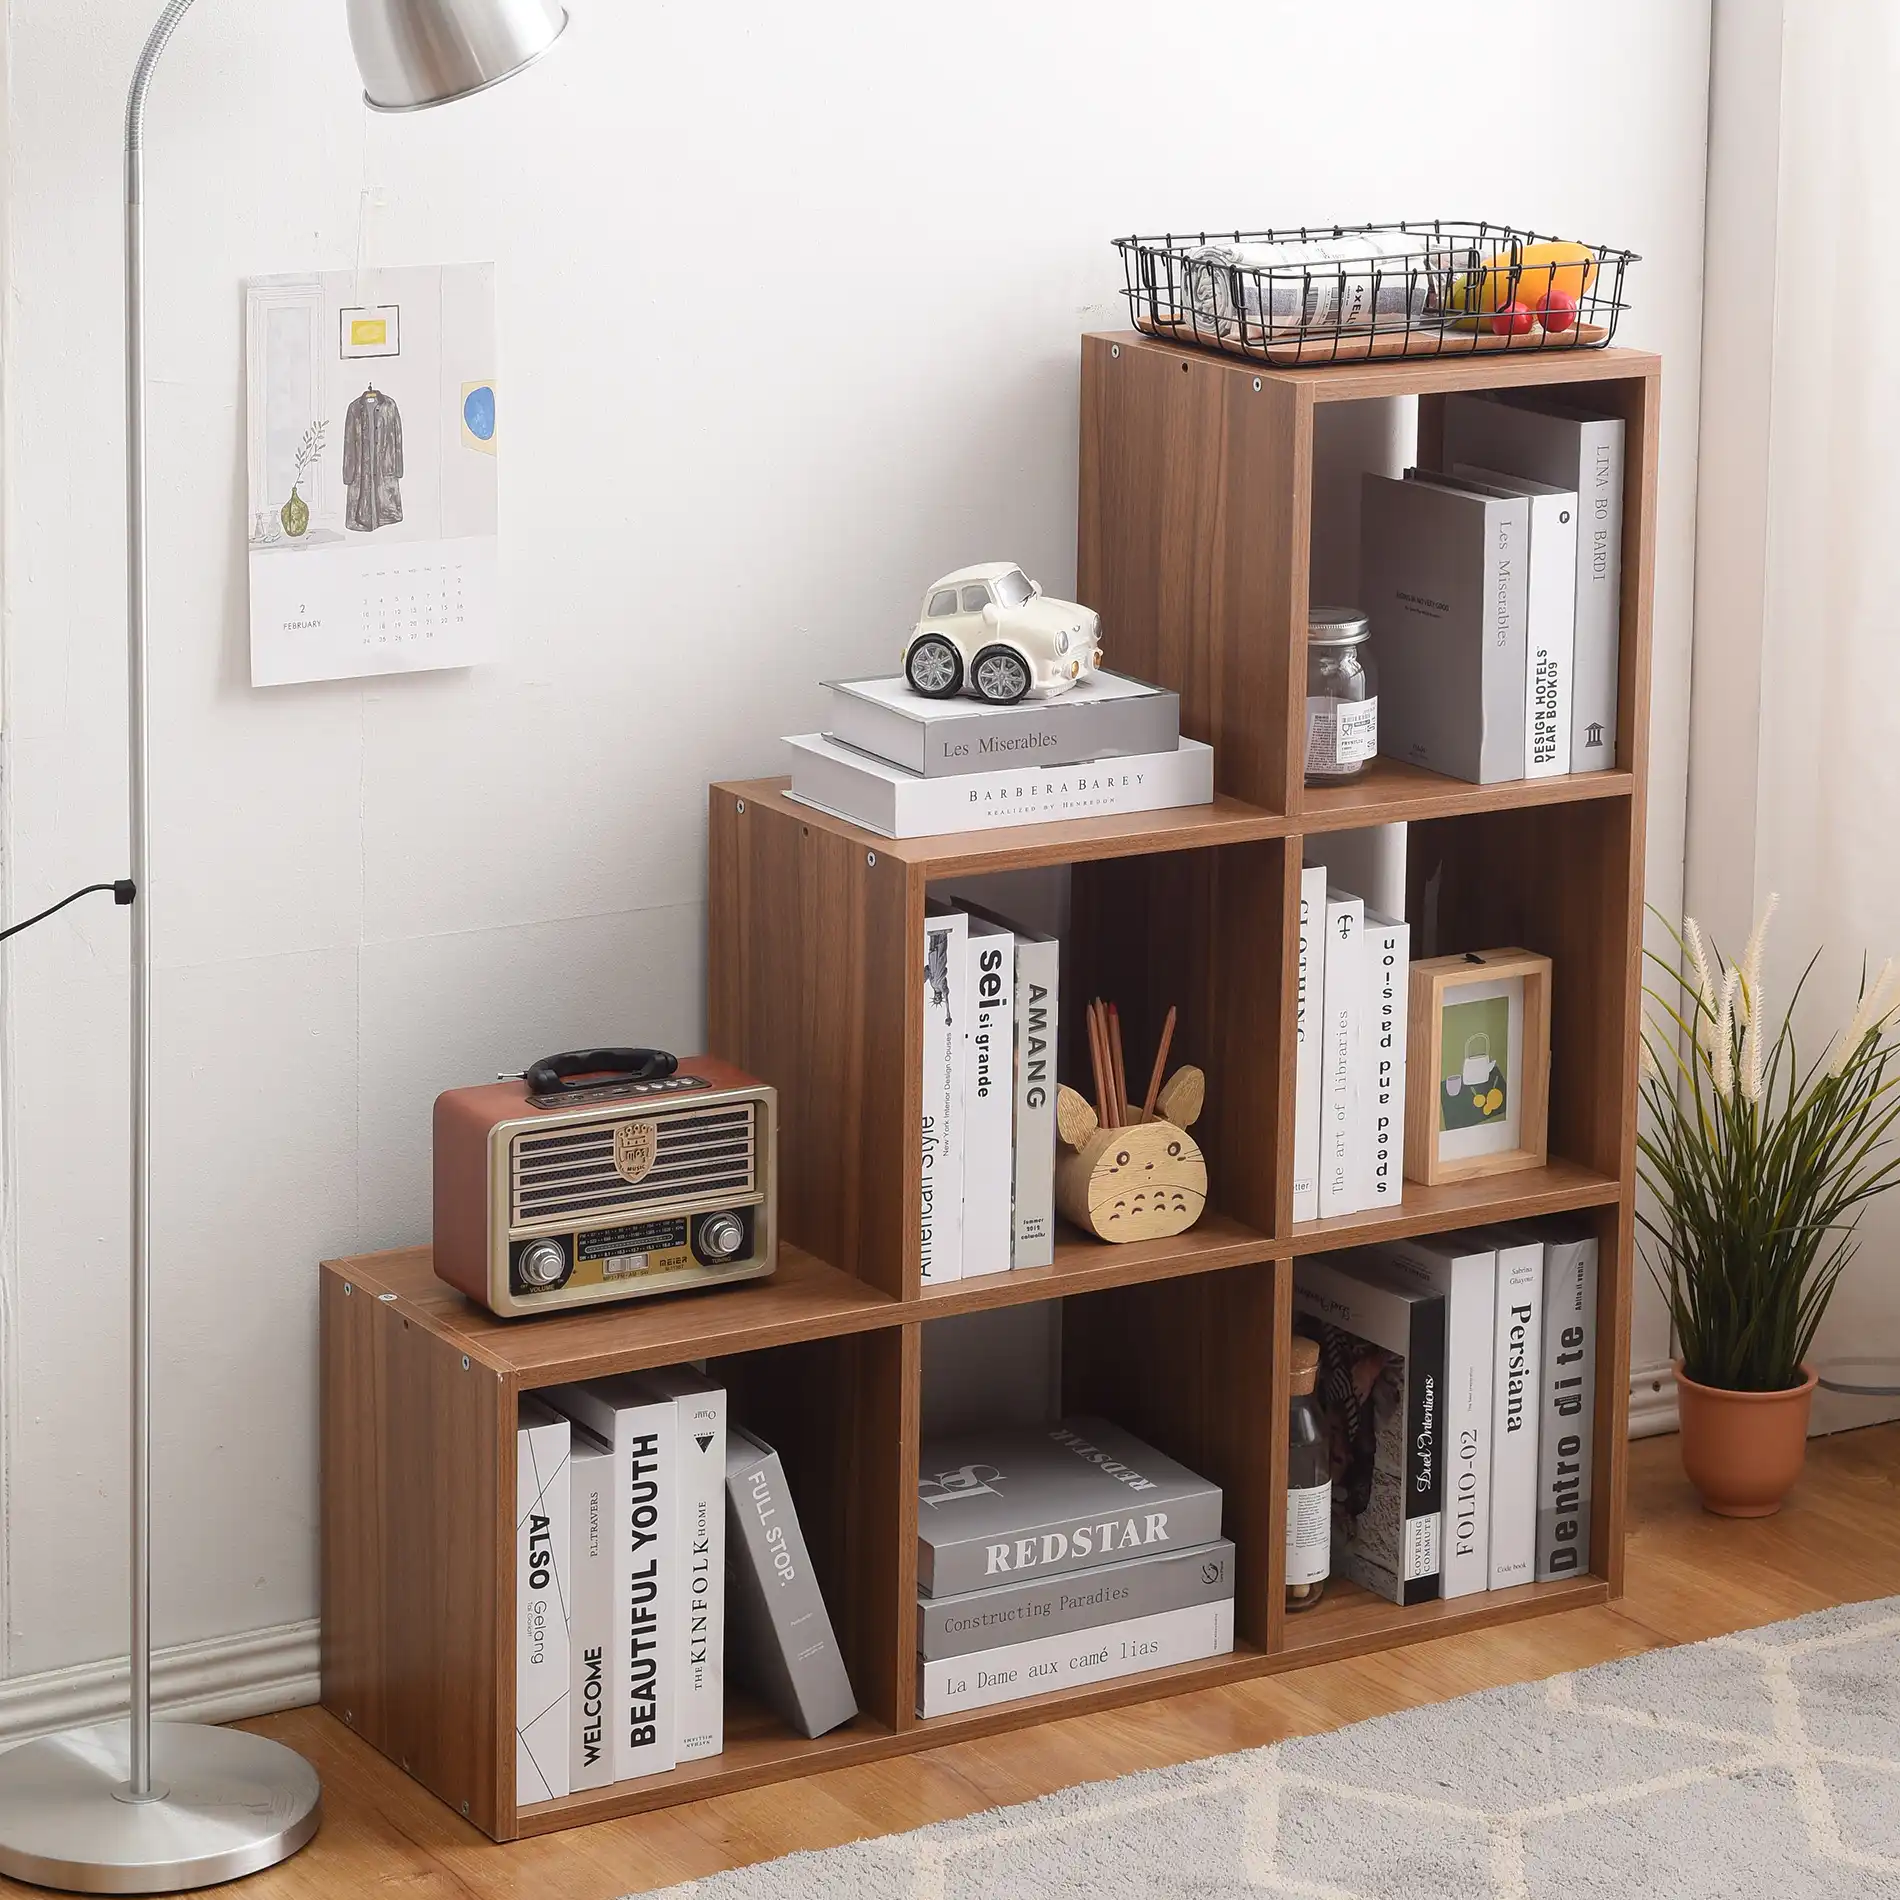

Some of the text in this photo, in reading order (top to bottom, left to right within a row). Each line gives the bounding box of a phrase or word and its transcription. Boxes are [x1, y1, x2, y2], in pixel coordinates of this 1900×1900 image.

[1594, 498, 1608, 520] BO
[1497, 520, 1512, 648] Les Miserables
[1592, 530, 1607, 581] BARDI
[283, 620, 322, 630] FEBRUARY
[299, 604, 306, 614] 2
[1534, 711, 1545, 763] DESIGN
[1545, 662, 1558, 762] YEAR BOOK09
[943, 732, 1058, 758] Les Miserables
[969, 774, 1144, 802] BARBERA BAREY
[987, 806, 1036, 816] REALIZED
[976, 949, 1007, 1098] sei si grande
[1026, 983, 1046, 1109] AMANG
[1376, 937, 1395, 1193] speed and passion
[1333, 1010, 1348, 1195] The art of libraries
[1294, 1181, 1310, 1192] tter
[530, 1284, 555, 1293] VOLUME
[1511, 1267, 1533, 1275] Sabrina
[1507, 1301, 1532, 1434] Persiana
[694, 1410, 717, 1419] Ouur
[1416, 1374, 1434, 1493] Duel Intentions
[1050, 1428, 1159, 1492] REDSTAR
[1549, 1325, 1584, 1572] Dentro di te
[590, 1492, 599, 1557] P.L.TRAVERS
[1455, 1428, 1478, 1557] FOLIO-02
[748, 1471, 795, 1587] FULL STOP.
[984, 1512, 1170, 1576] REDSTAR
[529, 1514, 550, 1665] ALSO Gelang
[631, 1433, 658, 1748] BEAUTIFUL YOUTH
[691, 1501, 710, 1691] THE KINFOLK HOME
[944, 1586, 1130, 1634] Constructing Paradies
[947, 1640, 1159, 1696] La Dame aux camé lias
[584, 1647, 602, 1767] WELCOME
[683, 1735, 713, 1743] WILLIAMS
[686, 1740, 710, 1748] NATHAN
